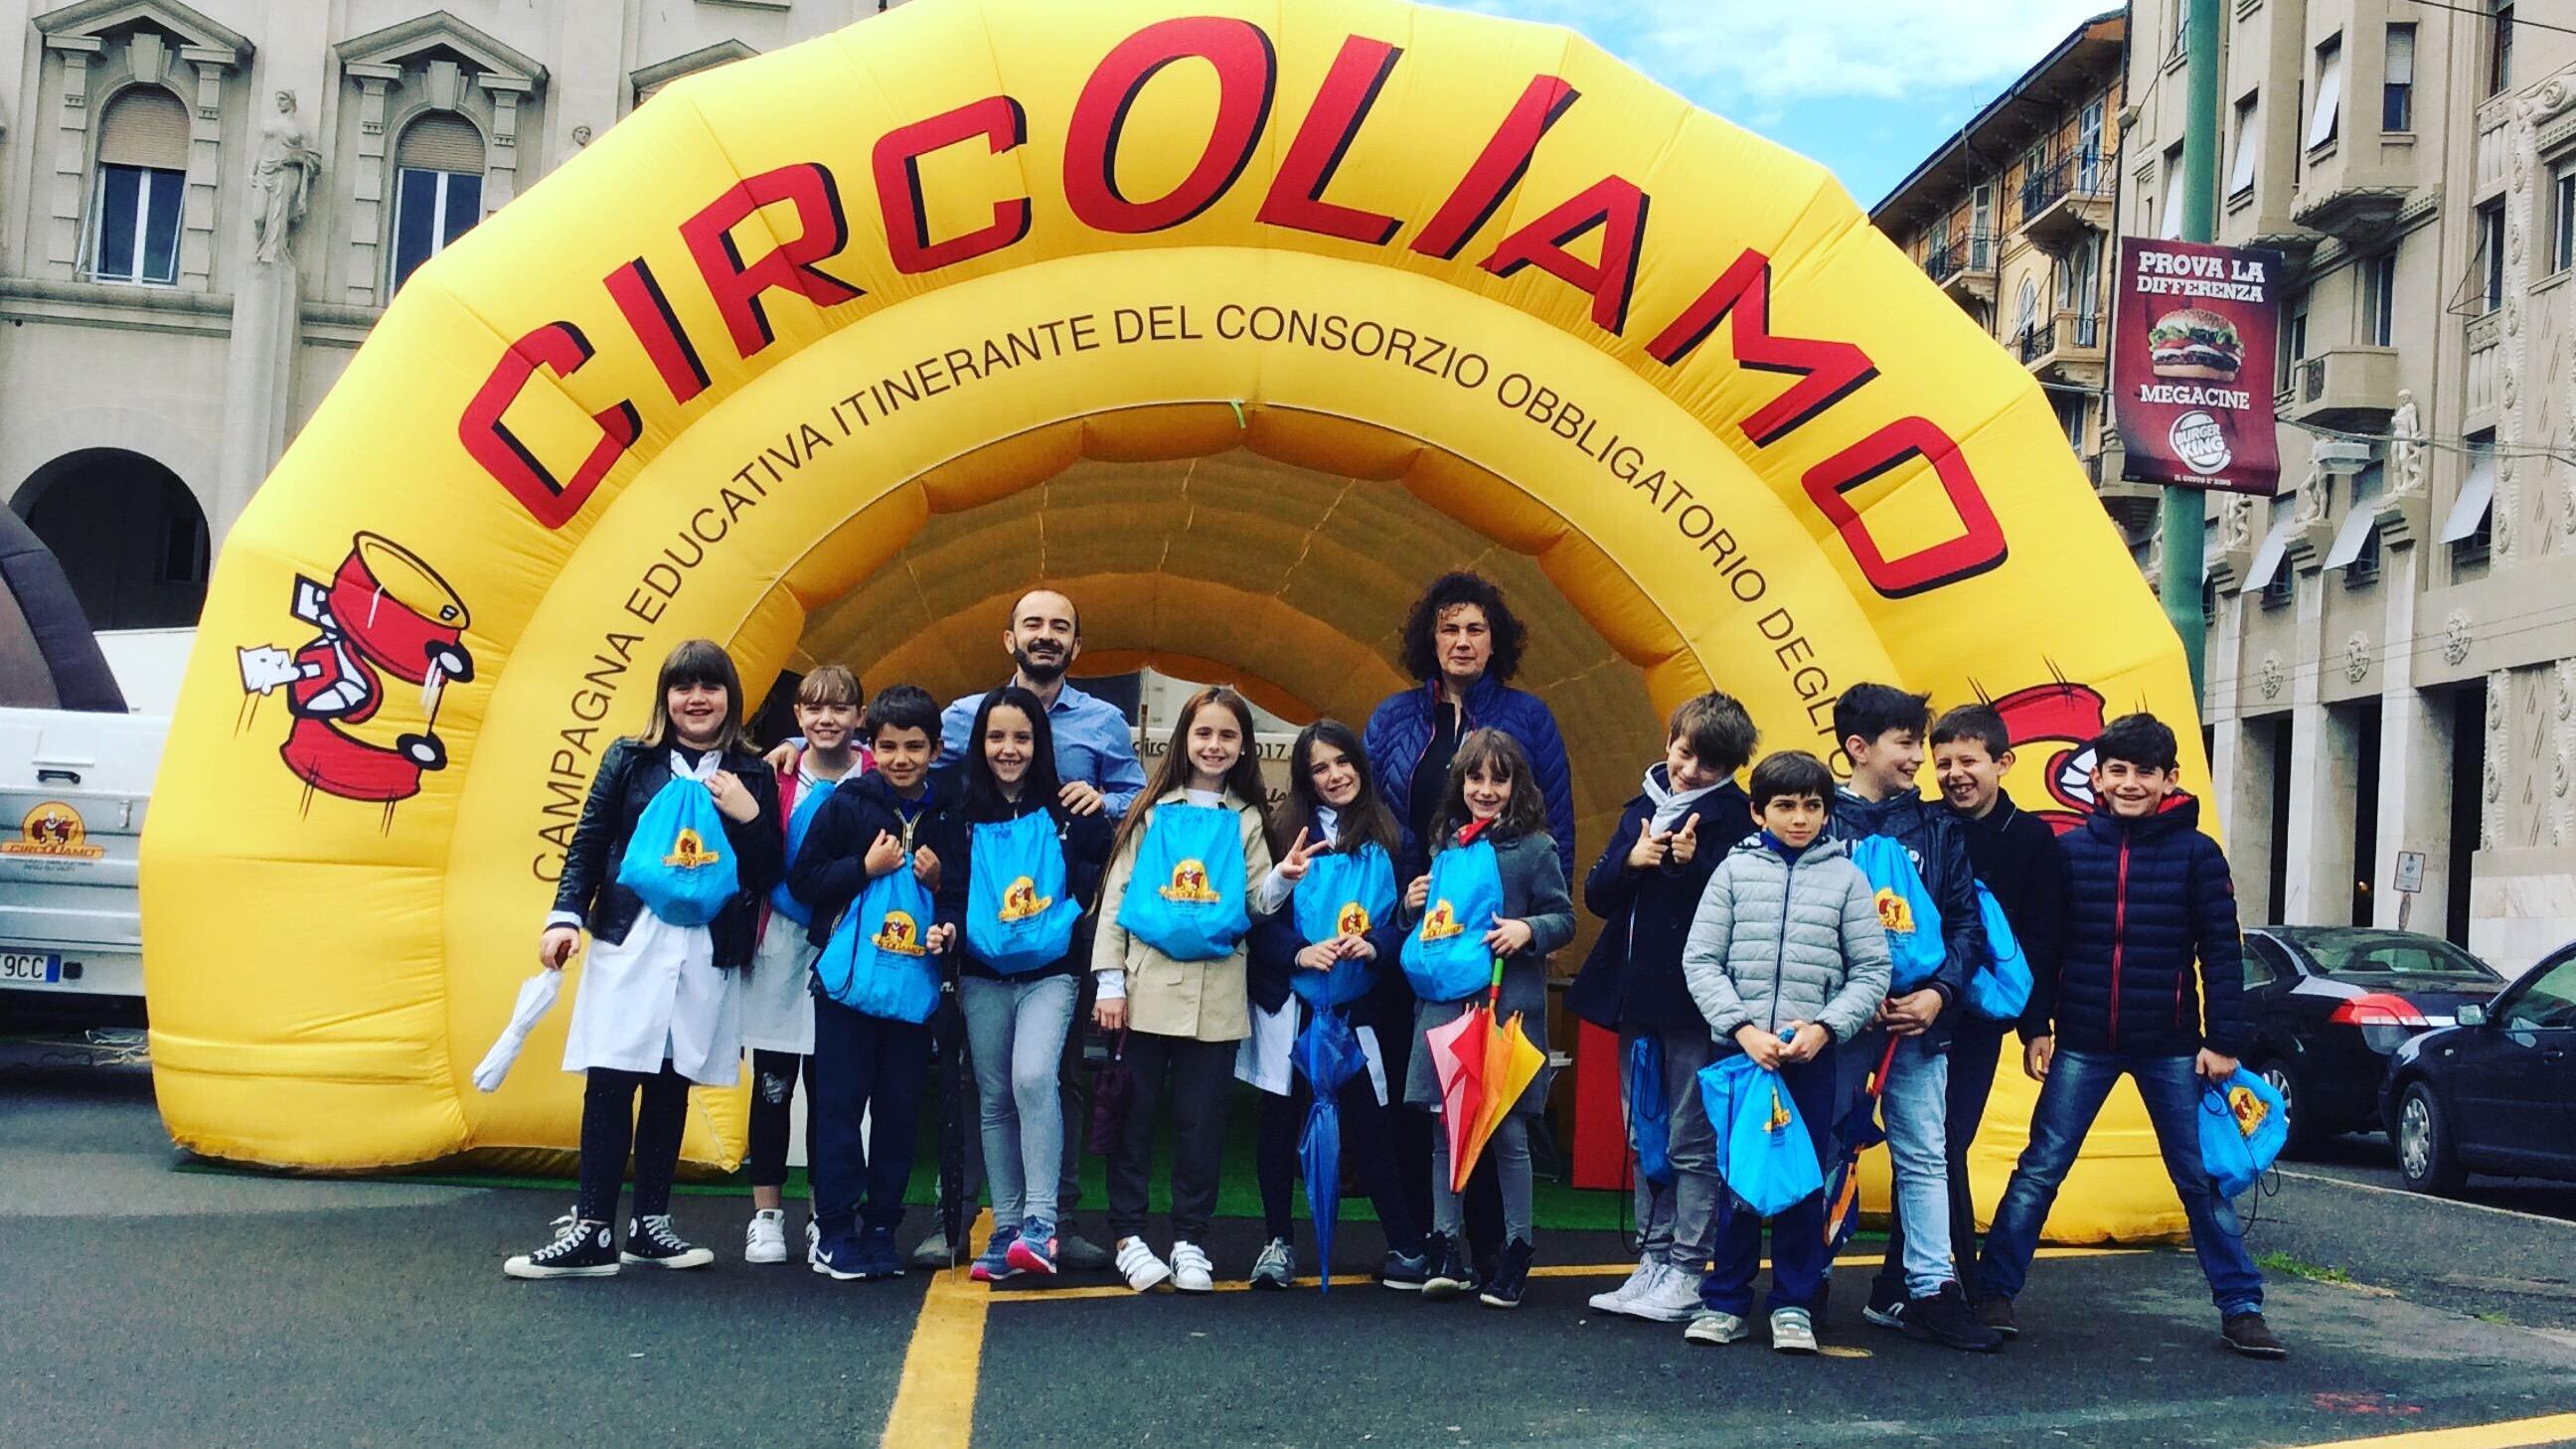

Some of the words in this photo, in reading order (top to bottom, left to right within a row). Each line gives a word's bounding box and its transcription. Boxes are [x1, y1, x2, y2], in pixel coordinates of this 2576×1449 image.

[2138, 250, 2224, 279] PROVA
[2231, 259, 2266, 283] LA
[2137, 274, 2264, 302] DIFFERENZA
[458, 16, 2008, 599] CIRCOLIAMO
[2140, 384, 2250, 410] MEGACINE
[2174, 423, 2221, 444] BURGER
[2177, 435, 2225, 458] KING
[533, 633, 645, 883] CAMPAGNA
[624, 422, 834, 624] EDUCATIVA
[831, 314, 1100, 436] ITINERANTE
[1113, 304, 1203, 344] DEL
[1216, 304, 1489, 389] CONSORZIO
[1497, 373, 1767, 602] OBBLIGATORIO
